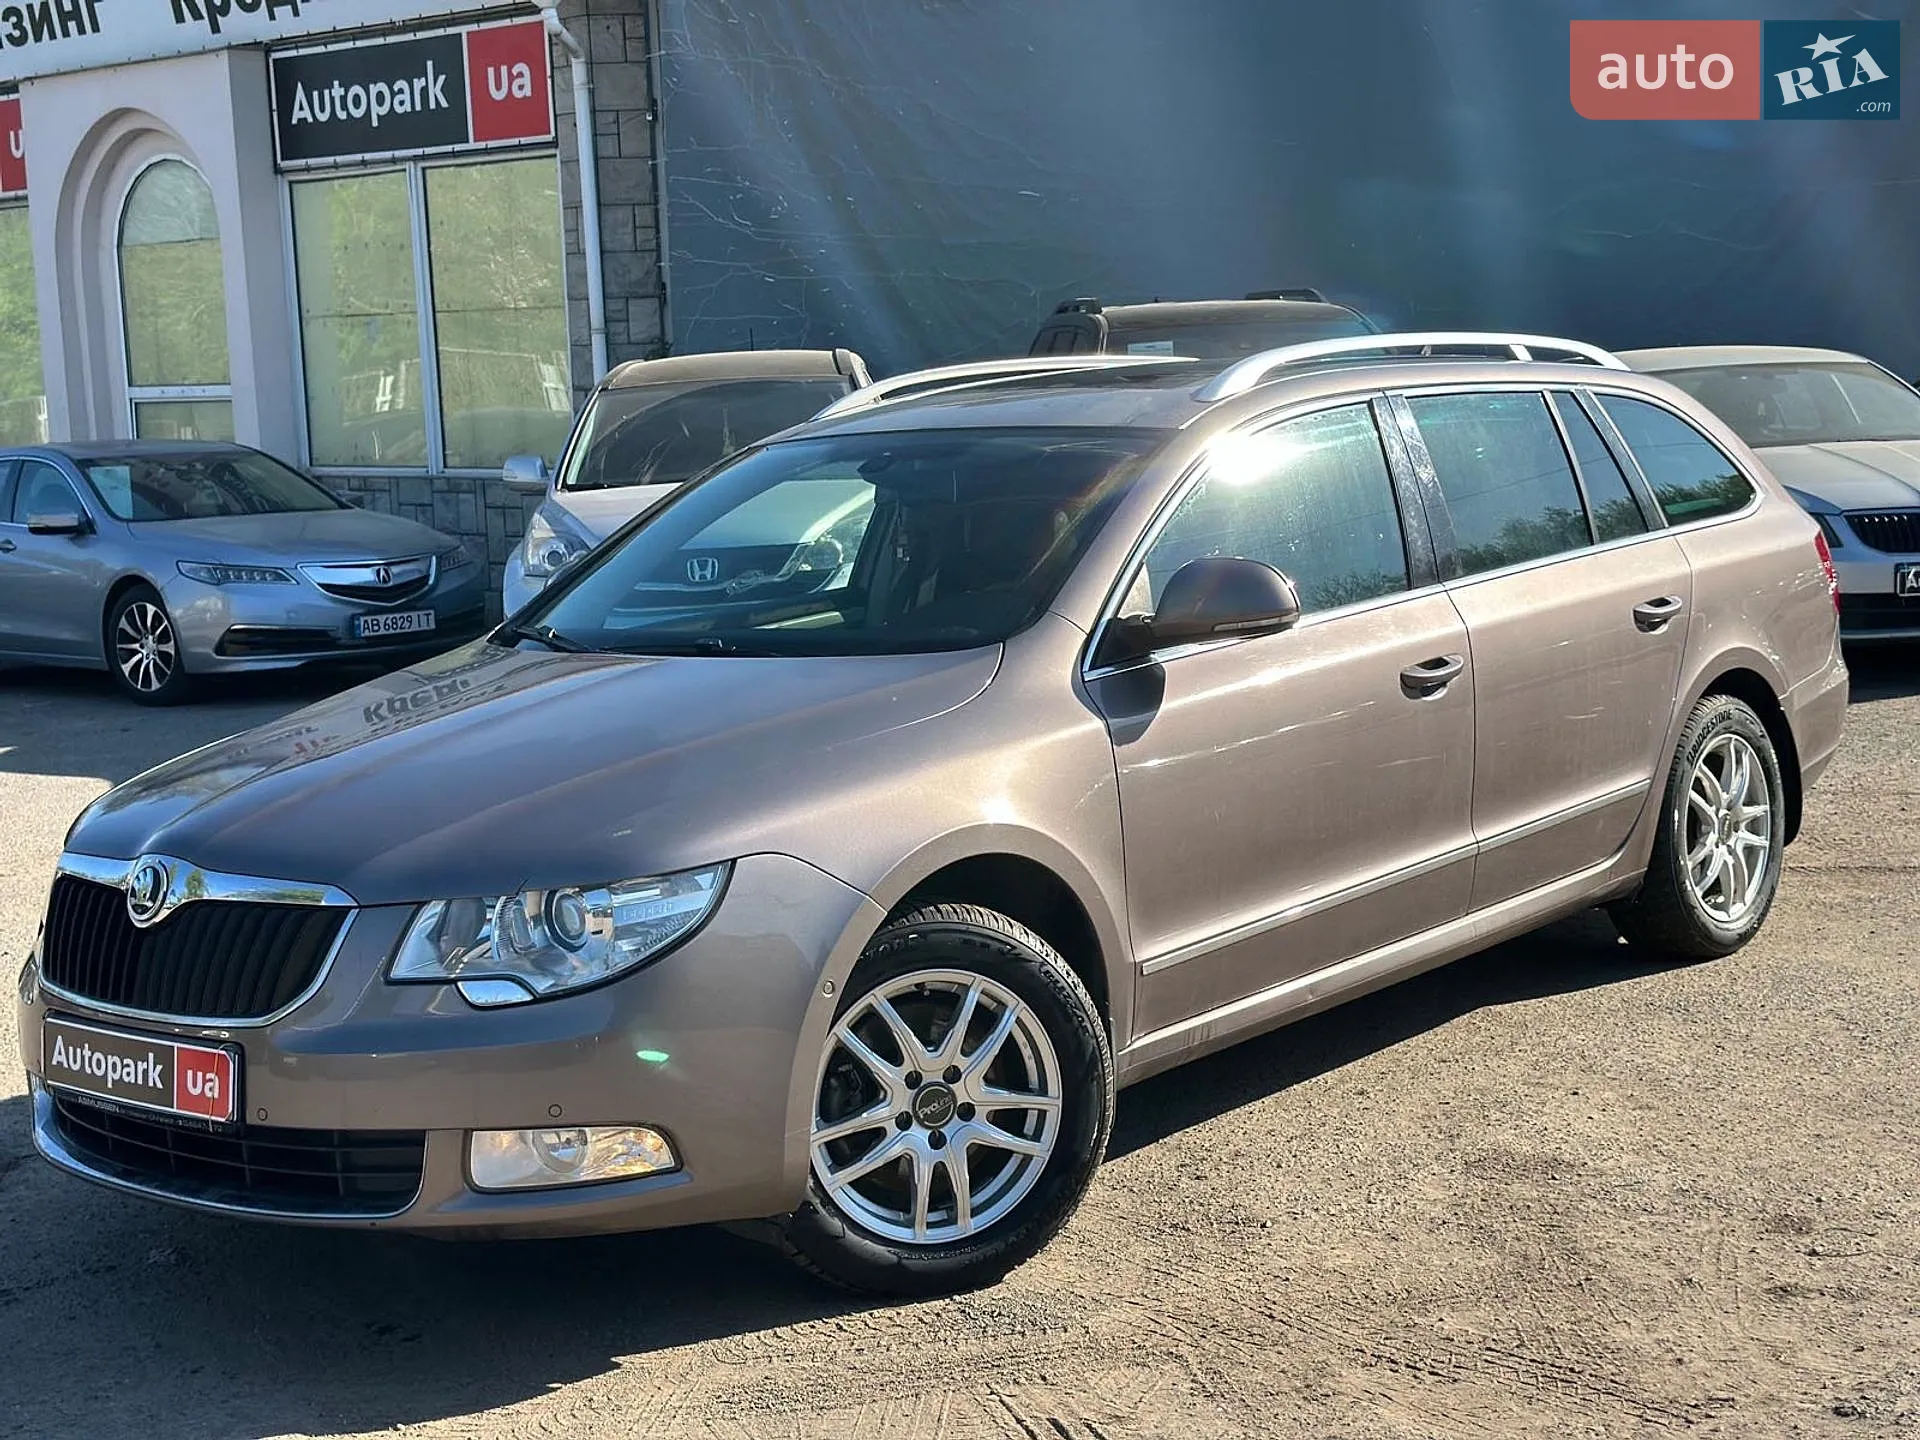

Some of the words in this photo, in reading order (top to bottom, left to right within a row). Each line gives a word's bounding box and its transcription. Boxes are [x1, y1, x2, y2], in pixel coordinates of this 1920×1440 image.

[291, 59, 449, 128] Autopark
[487, 61, 532, 101] ua
[362, 617, 381, 634] AB
[383, 615, 413, 632] 6829
[51, 1034, 164, 1089] Autopark
[186, 1068, 220, 1100] ua
